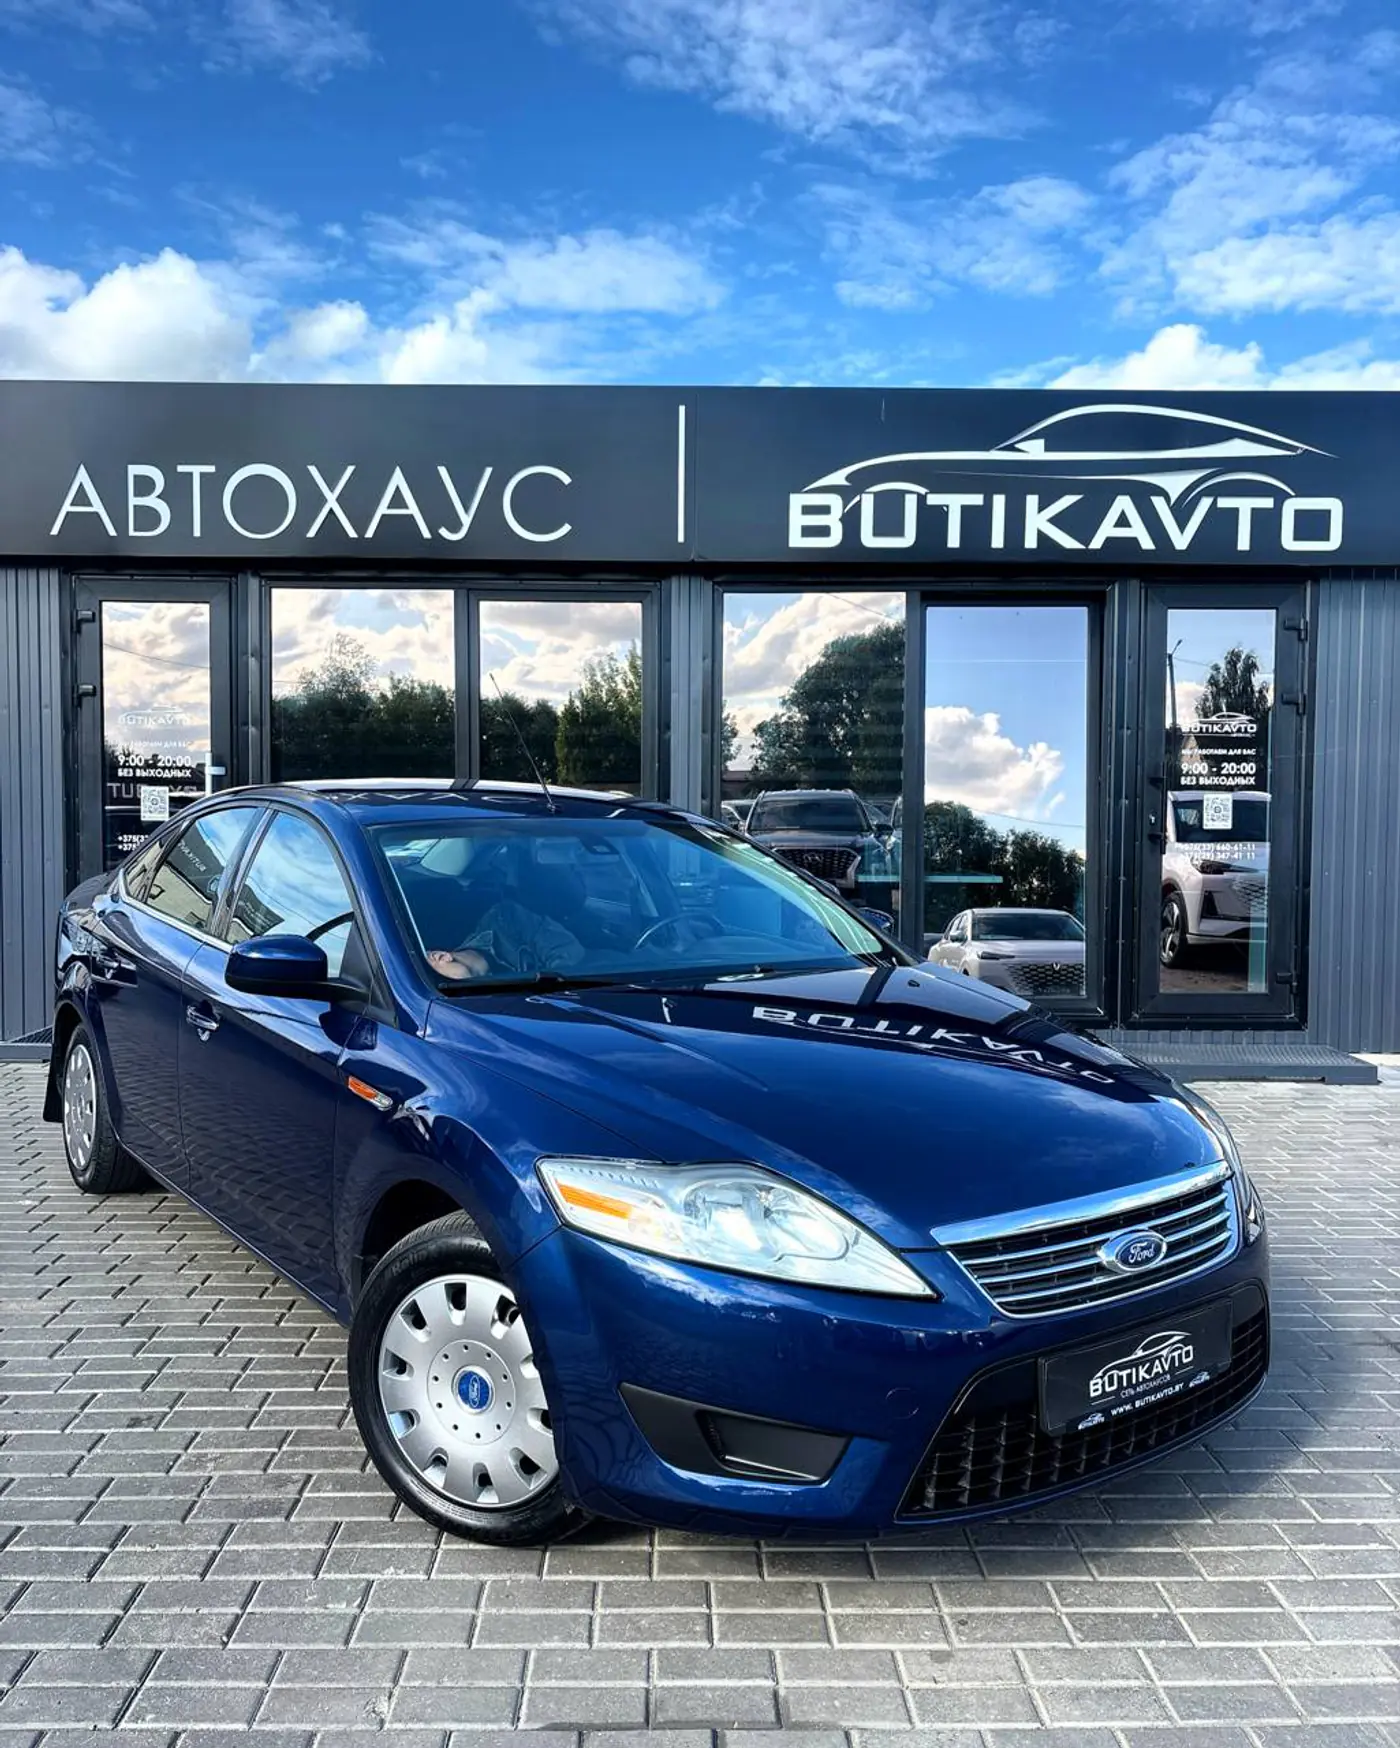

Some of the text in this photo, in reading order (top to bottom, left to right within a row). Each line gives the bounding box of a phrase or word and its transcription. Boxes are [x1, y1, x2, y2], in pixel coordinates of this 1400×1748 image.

[50, 463, 573, 543] АВТОХАУС
[788, 491, 1343, 552] BUTIKAVTO
[117, 755, 144, 767] 9:00
[157, 755, 191, 767] 20:00
[1181, 763, 1208, 775] 9:00
[1221, 762, 1257, 775] 20:00
[117, 768, 192, 778] БЕЗ ВЫХОДНЫХ
[1181, 777, 1256, 785] БЕЗ ВЫХОДНЫХ
[1128, 1241, 1155, 1263] Ford
[1089, 1345, 1194, 1398] BUTIKAVTO
[1134, 1382, 1184, 1409] BUTIKAVTO.BY
